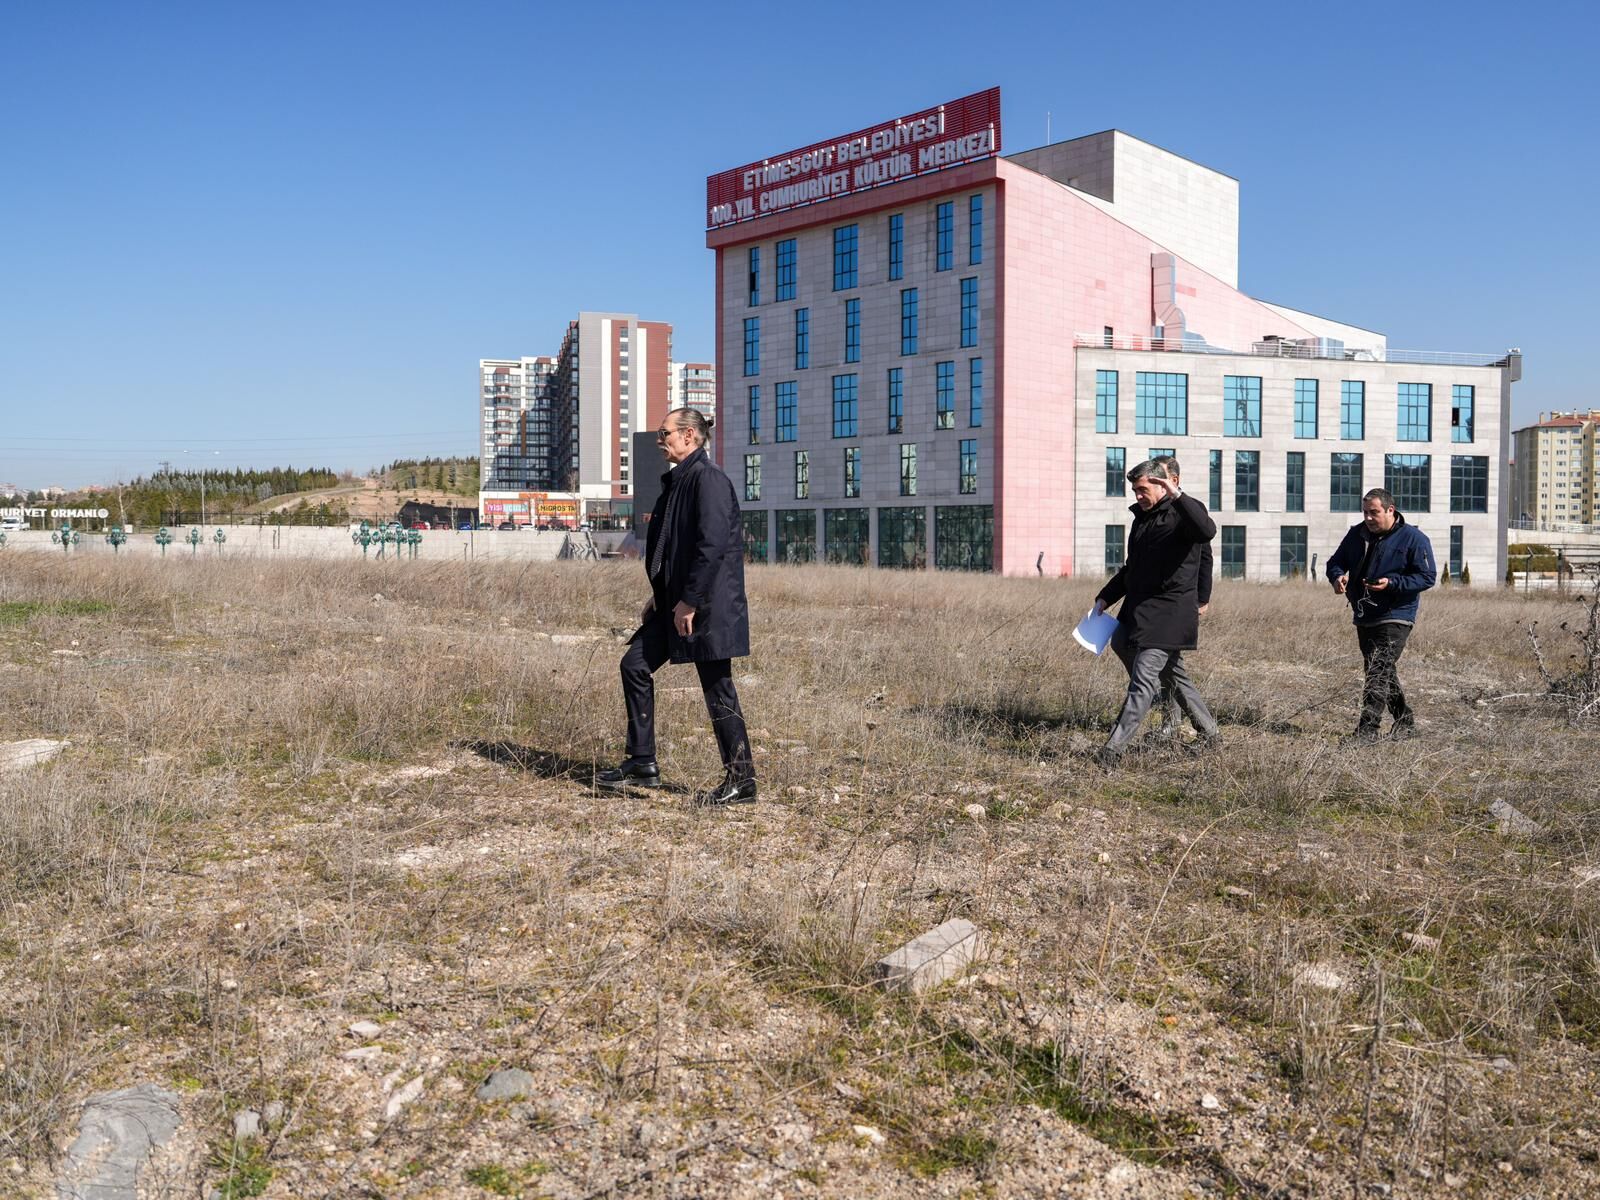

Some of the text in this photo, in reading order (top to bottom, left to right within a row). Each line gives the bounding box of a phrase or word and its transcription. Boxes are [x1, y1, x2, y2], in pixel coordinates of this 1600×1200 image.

[743, 105, 945, 191] ETİMESGUT BELEDİYESİ
[759, 169, 849, 211] CUMHURİYET
[854, 150, 912, 188] KÜLTÜR
[918, 122, 995, 168] MERKEZİ
[51, 508, 98, 518] ORMANI
